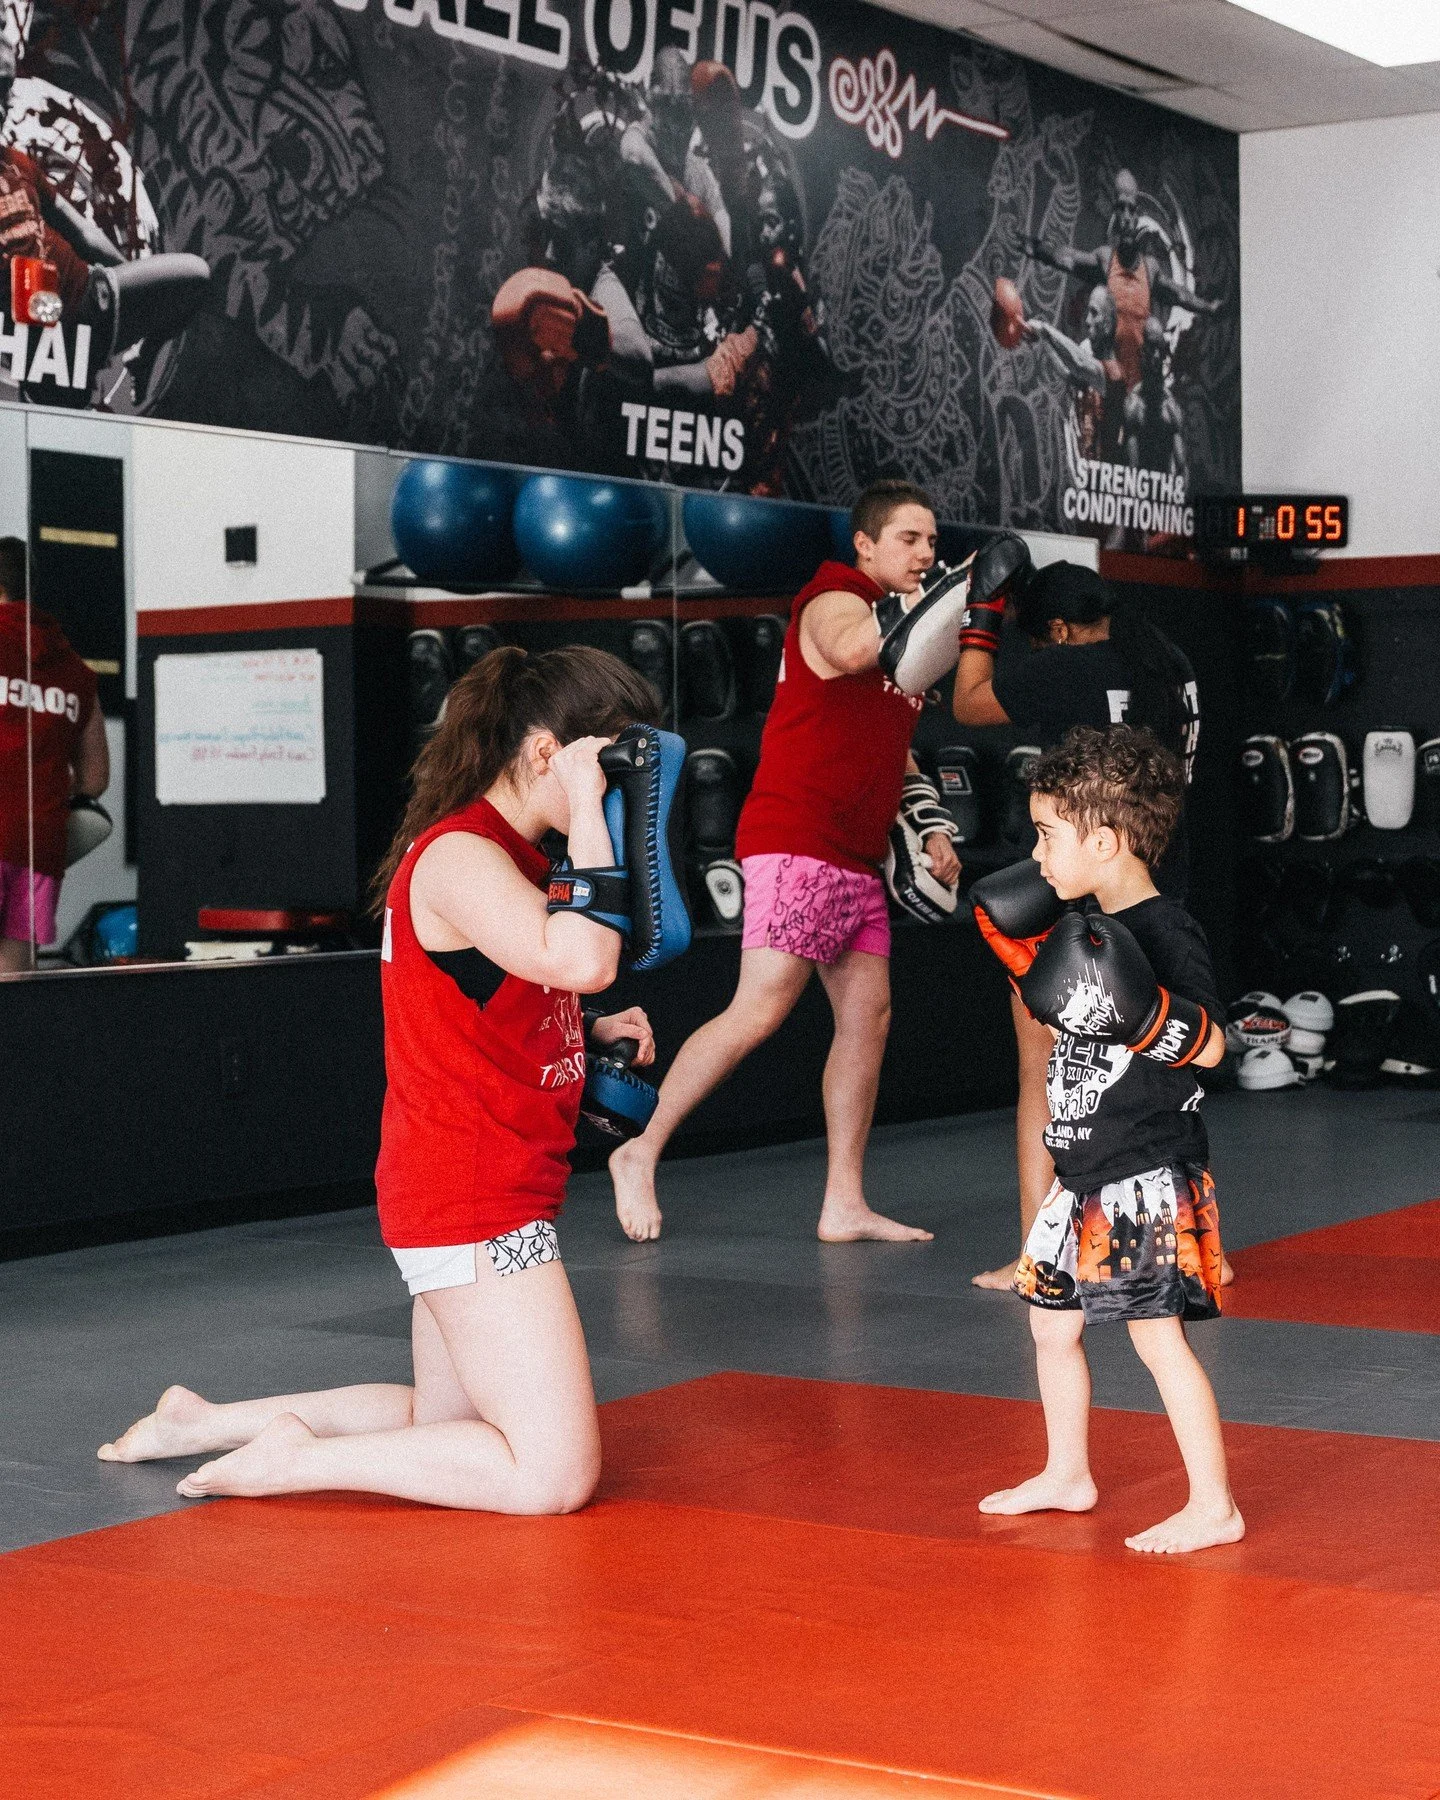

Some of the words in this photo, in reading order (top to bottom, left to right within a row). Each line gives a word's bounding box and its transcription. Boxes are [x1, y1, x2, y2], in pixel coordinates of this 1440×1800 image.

[584, 0, 702, 96] OF
[714, 0, 821, 139] US
[621, 402, 745, 471] TEENS
[1063, 487, 1194, 536] CONDITIONING
[1077, 1126, 1093, 1140] NY
